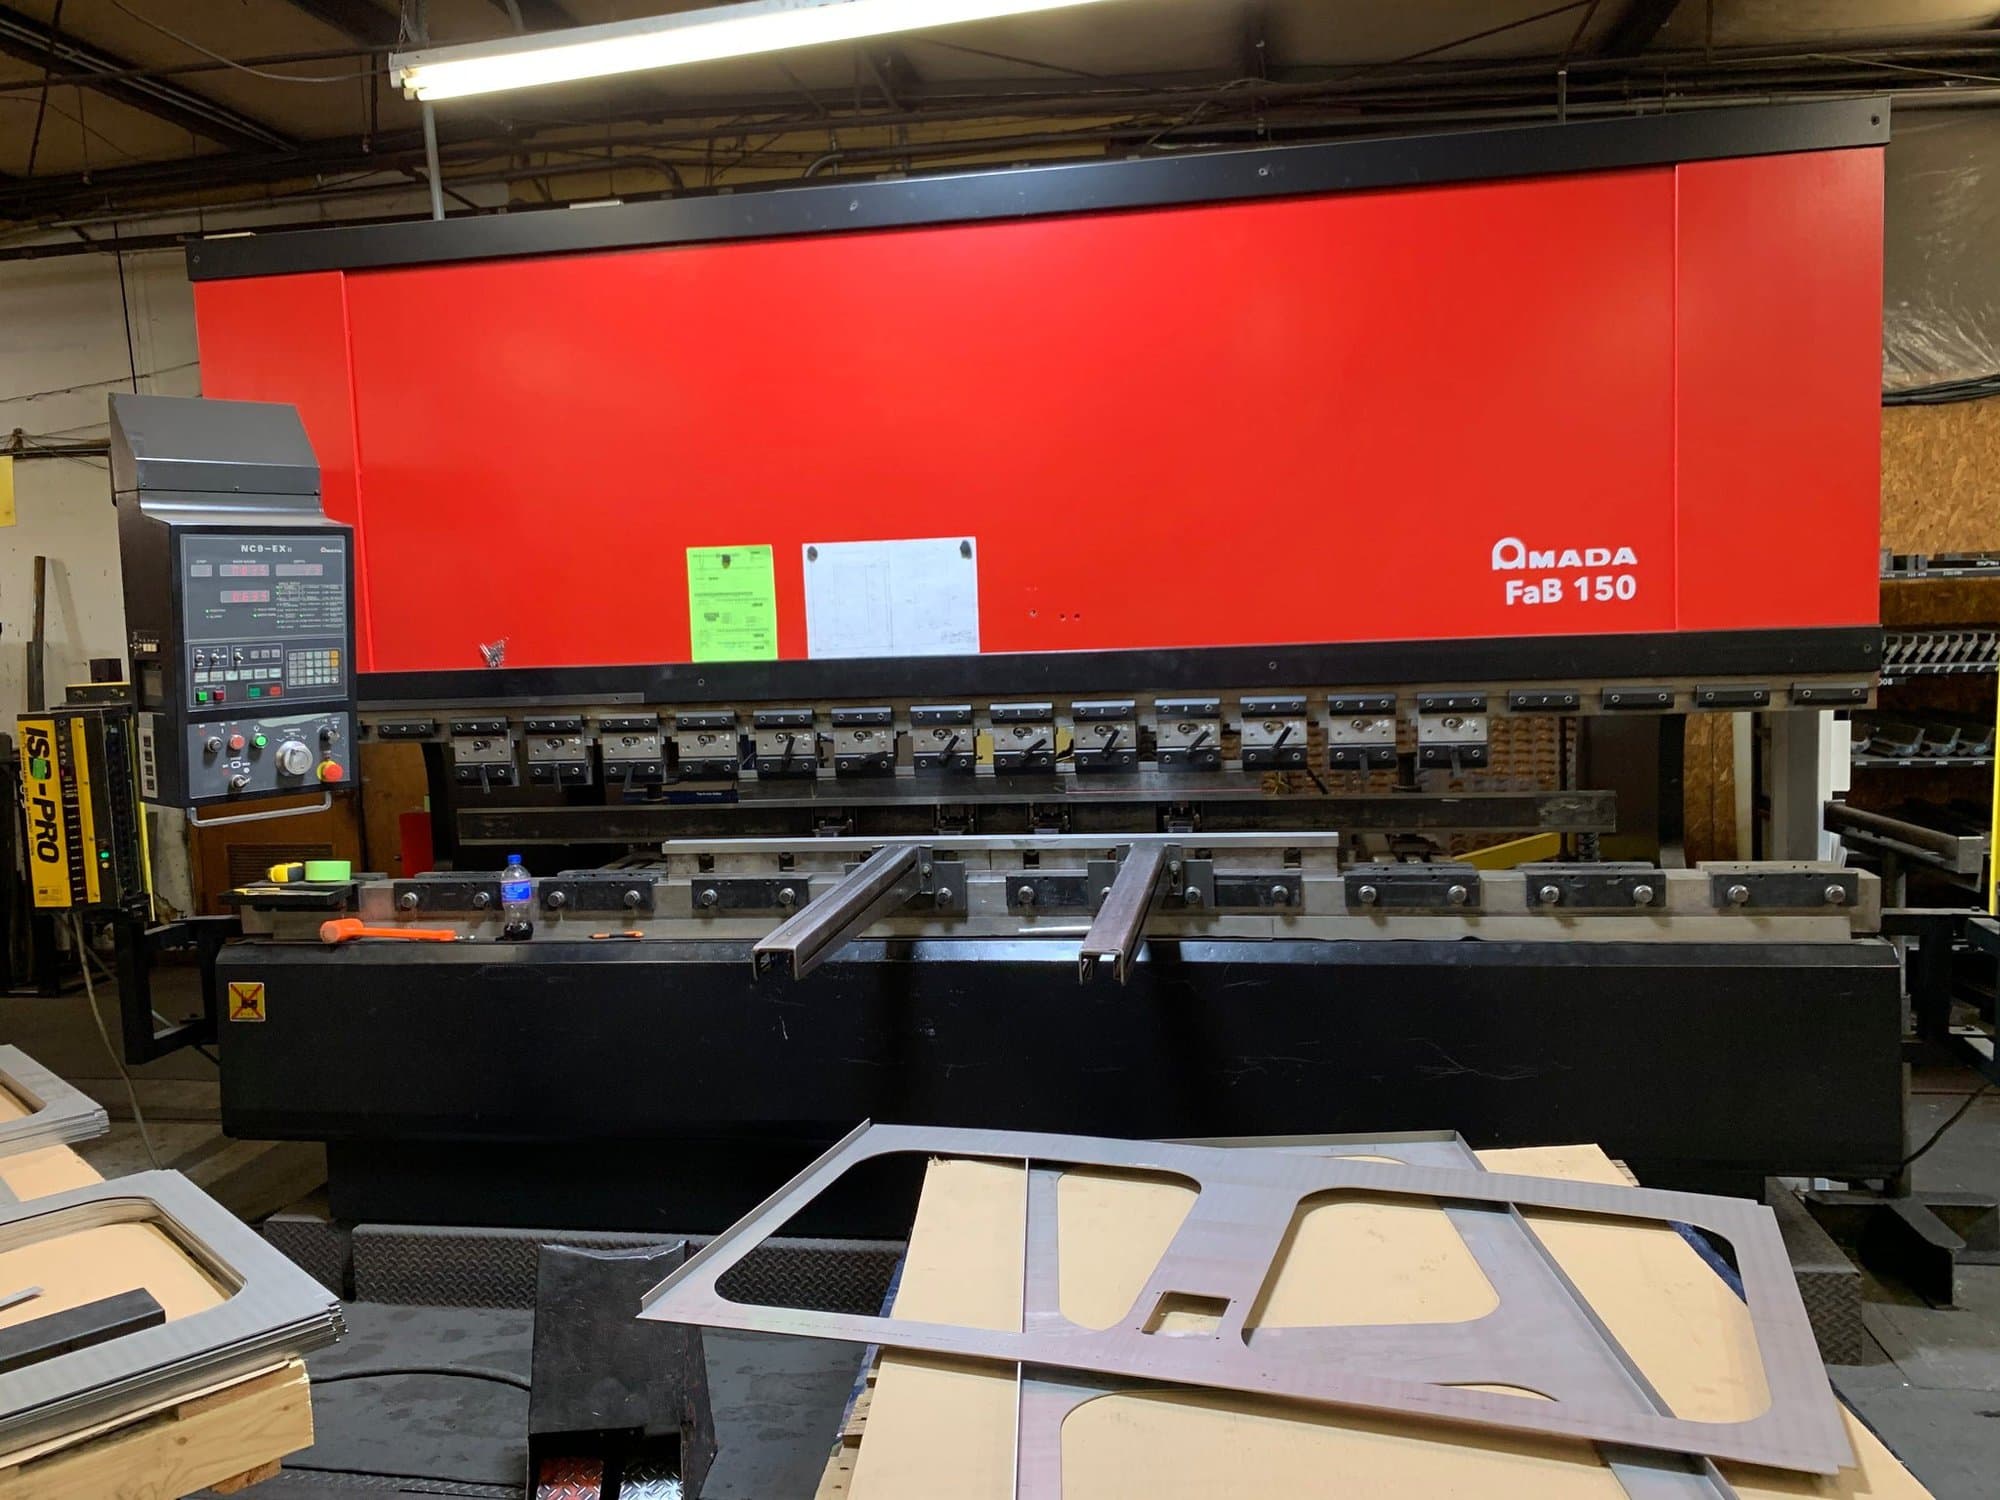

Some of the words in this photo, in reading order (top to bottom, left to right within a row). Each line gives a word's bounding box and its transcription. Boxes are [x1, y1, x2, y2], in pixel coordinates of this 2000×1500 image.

[1492, 537, 1638, 570] AMADA
[1506, 578, 1563, 606] FaB
[1574, 574, 1636, 602] 150
